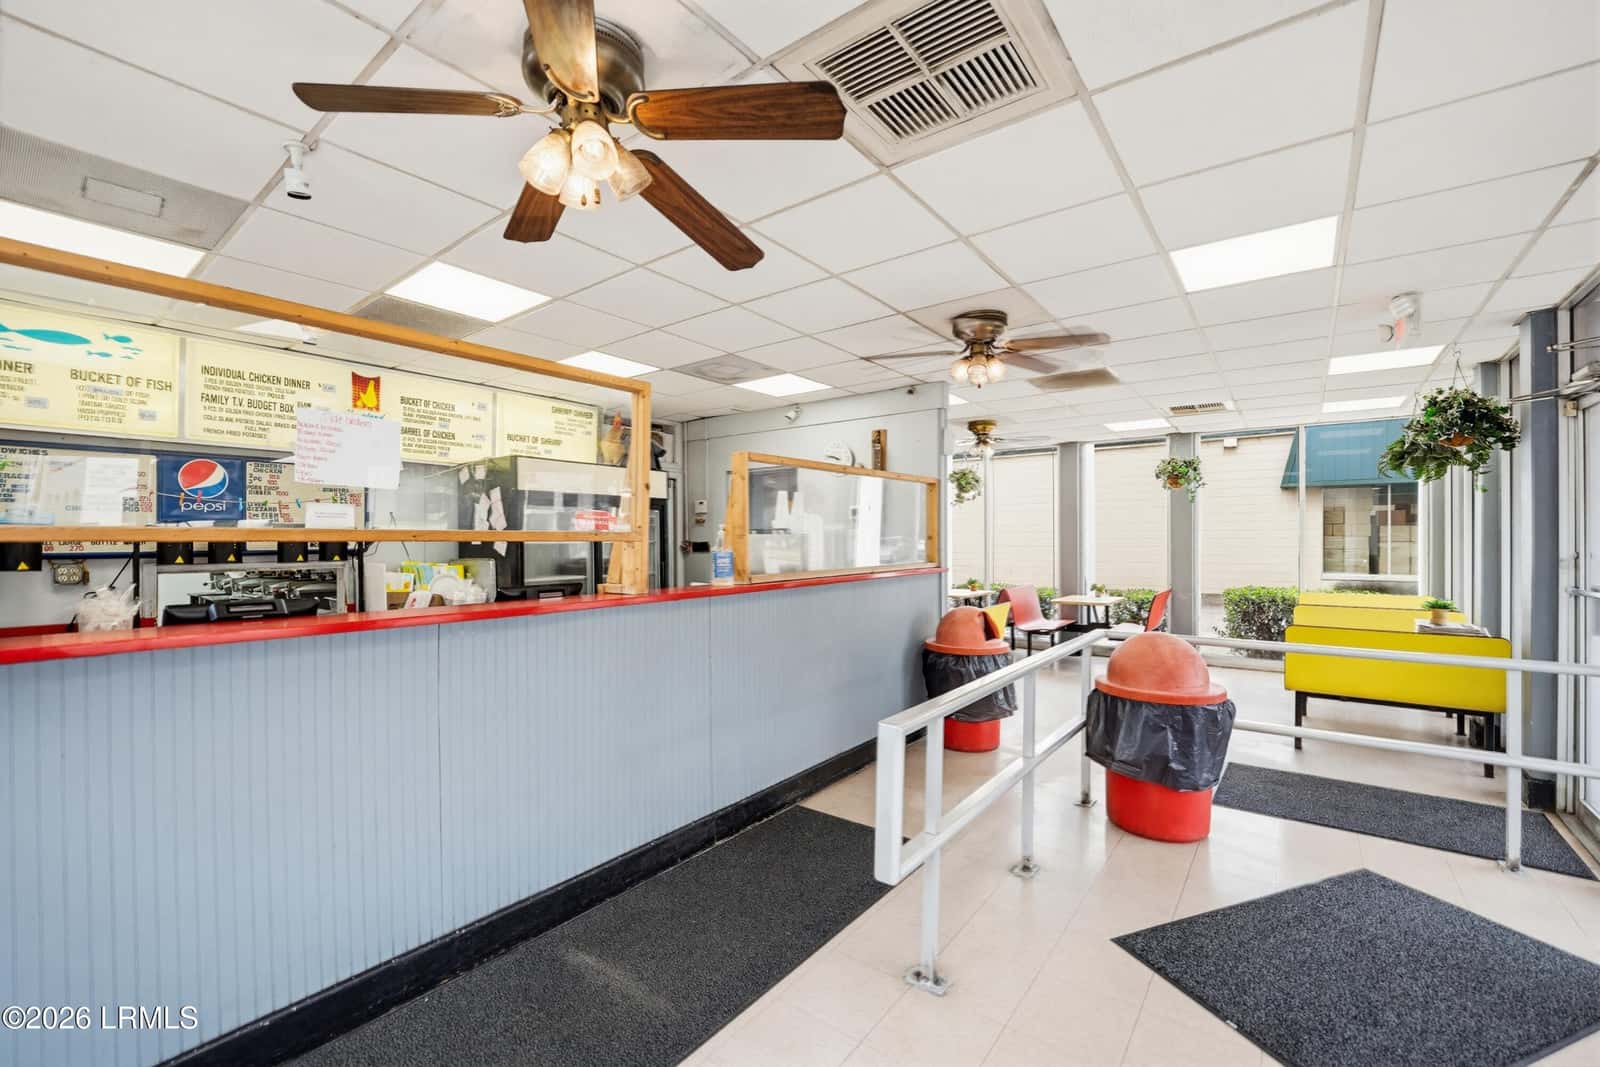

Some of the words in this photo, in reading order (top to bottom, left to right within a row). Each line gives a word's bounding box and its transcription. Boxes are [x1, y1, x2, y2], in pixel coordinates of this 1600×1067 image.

[70, 368, 123, 385] BUCKET
[126, 376, 142, 388] OF
[146, 379, 173, 392] FISH
[201, 365, 246, 381] INDIVIDUAL
[249, 372, 282, 385] CHICKEN
[284, 377, 311, 390] DINNER
[200, 393, 229, 406] FAMILY
[247, 399, 277, 411] BUDGET
[280, 402, 295, 414] BOX
[400, 396, 422, 407] BUCKET
[424, 400, 431, 408] OF
[432, 401, 456, 412] CHICKEN
[432, 430, 456, 441] CHICKEN
[507, 433, 530, 443] BUCKET
[532, 436, 539, 444] OF
[180, 501, 226, 513] pepsi
